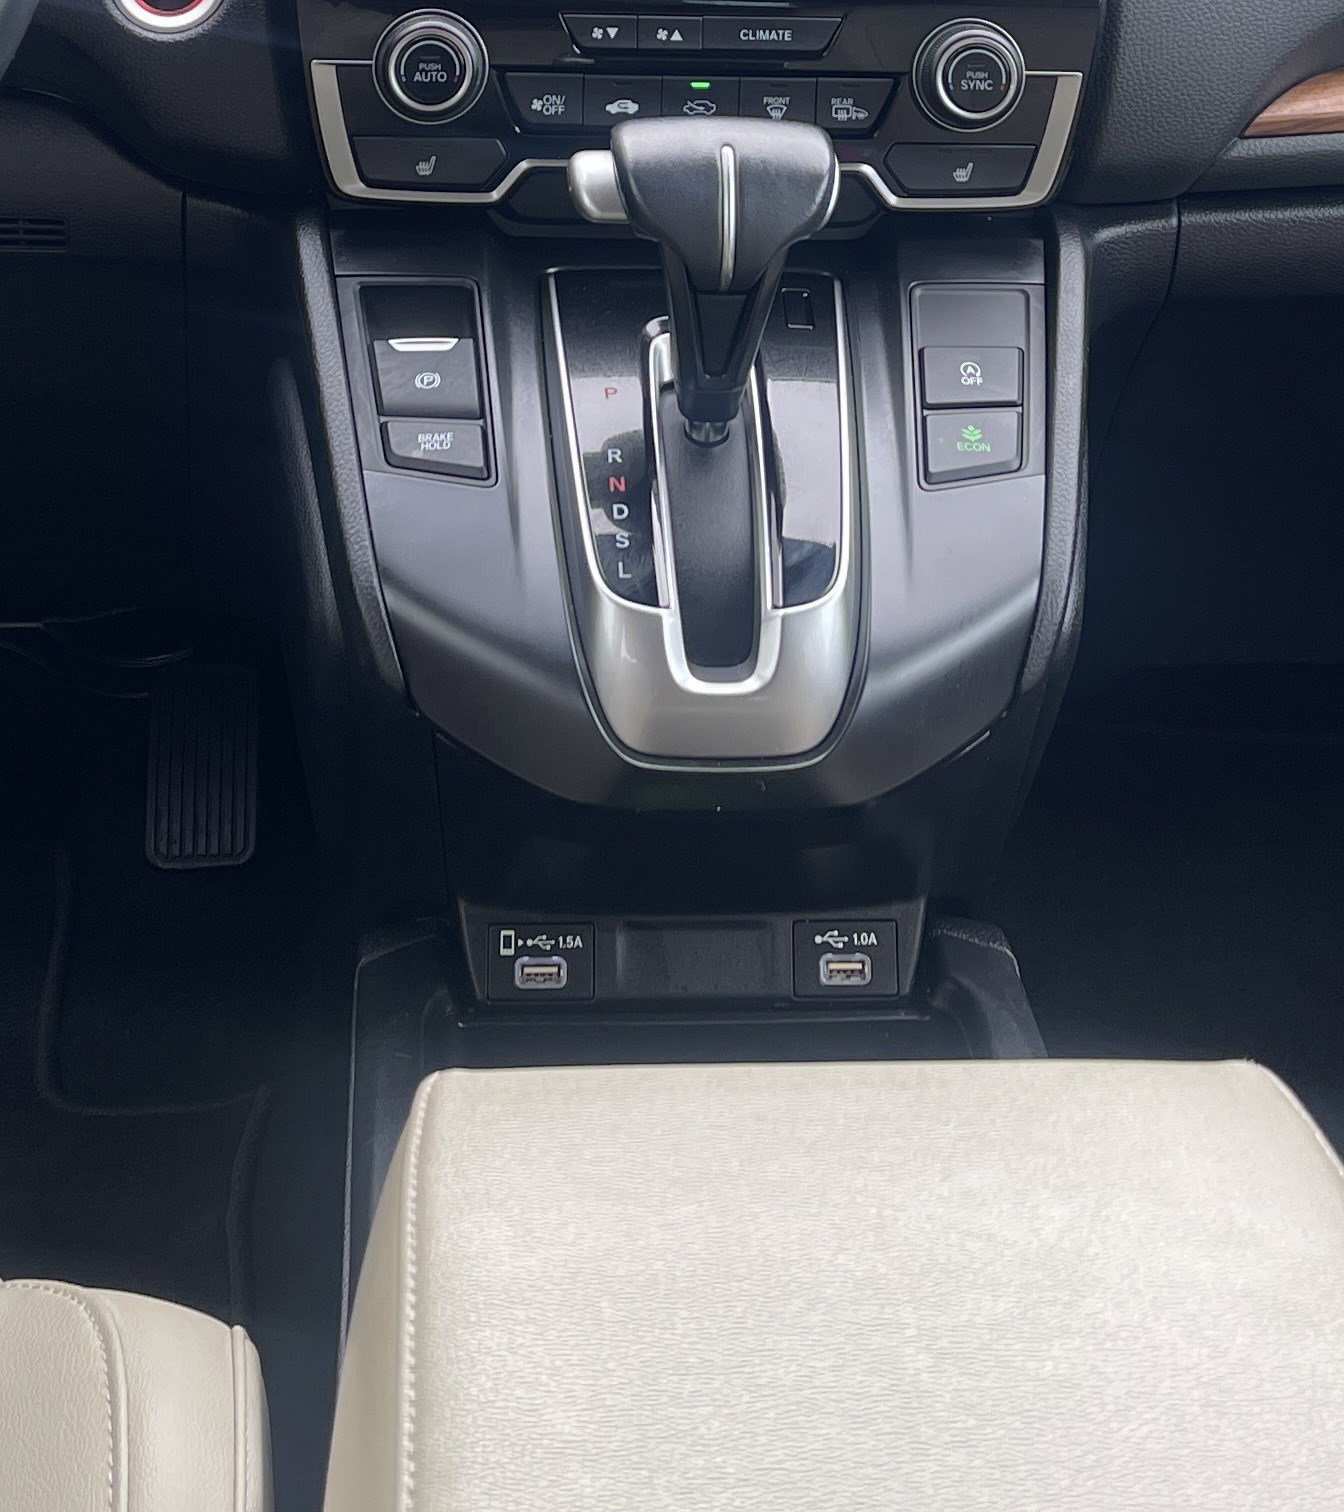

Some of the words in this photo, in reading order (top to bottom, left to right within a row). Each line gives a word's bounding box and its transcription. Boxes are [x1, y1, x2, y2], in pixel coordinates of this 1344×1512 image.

[739, 29, 793, 41] CLIMATE
[418, 62, 442, 71] PUSH
[413, 71, 448, 83] AUTO
[966, 70, 989, 79] PUSH
[960, 79, 994, 91] SYNC
[763, 96, 791, 106] FRONT
[830, 97, 854, 106] REAR
[542, 103, 566, 116] OFF
[960, 376, 984, 386] OFF
[605, 387, 618, 399] P
[417, 431, 454, 443] BRAKE
[420, 440, 451, 451] HOLD
[956, 441, 991, 453] ECON
[607, 448, 623, 463] R
[608, 475, 626, 492] N
[612, 503, 629, 520] D
[615, 532, 630, 548] S
[617, 562, 632, 579] L
[557, 934, 584, 950] 1.5A
[852, 932, 878, 948] 1.0A
